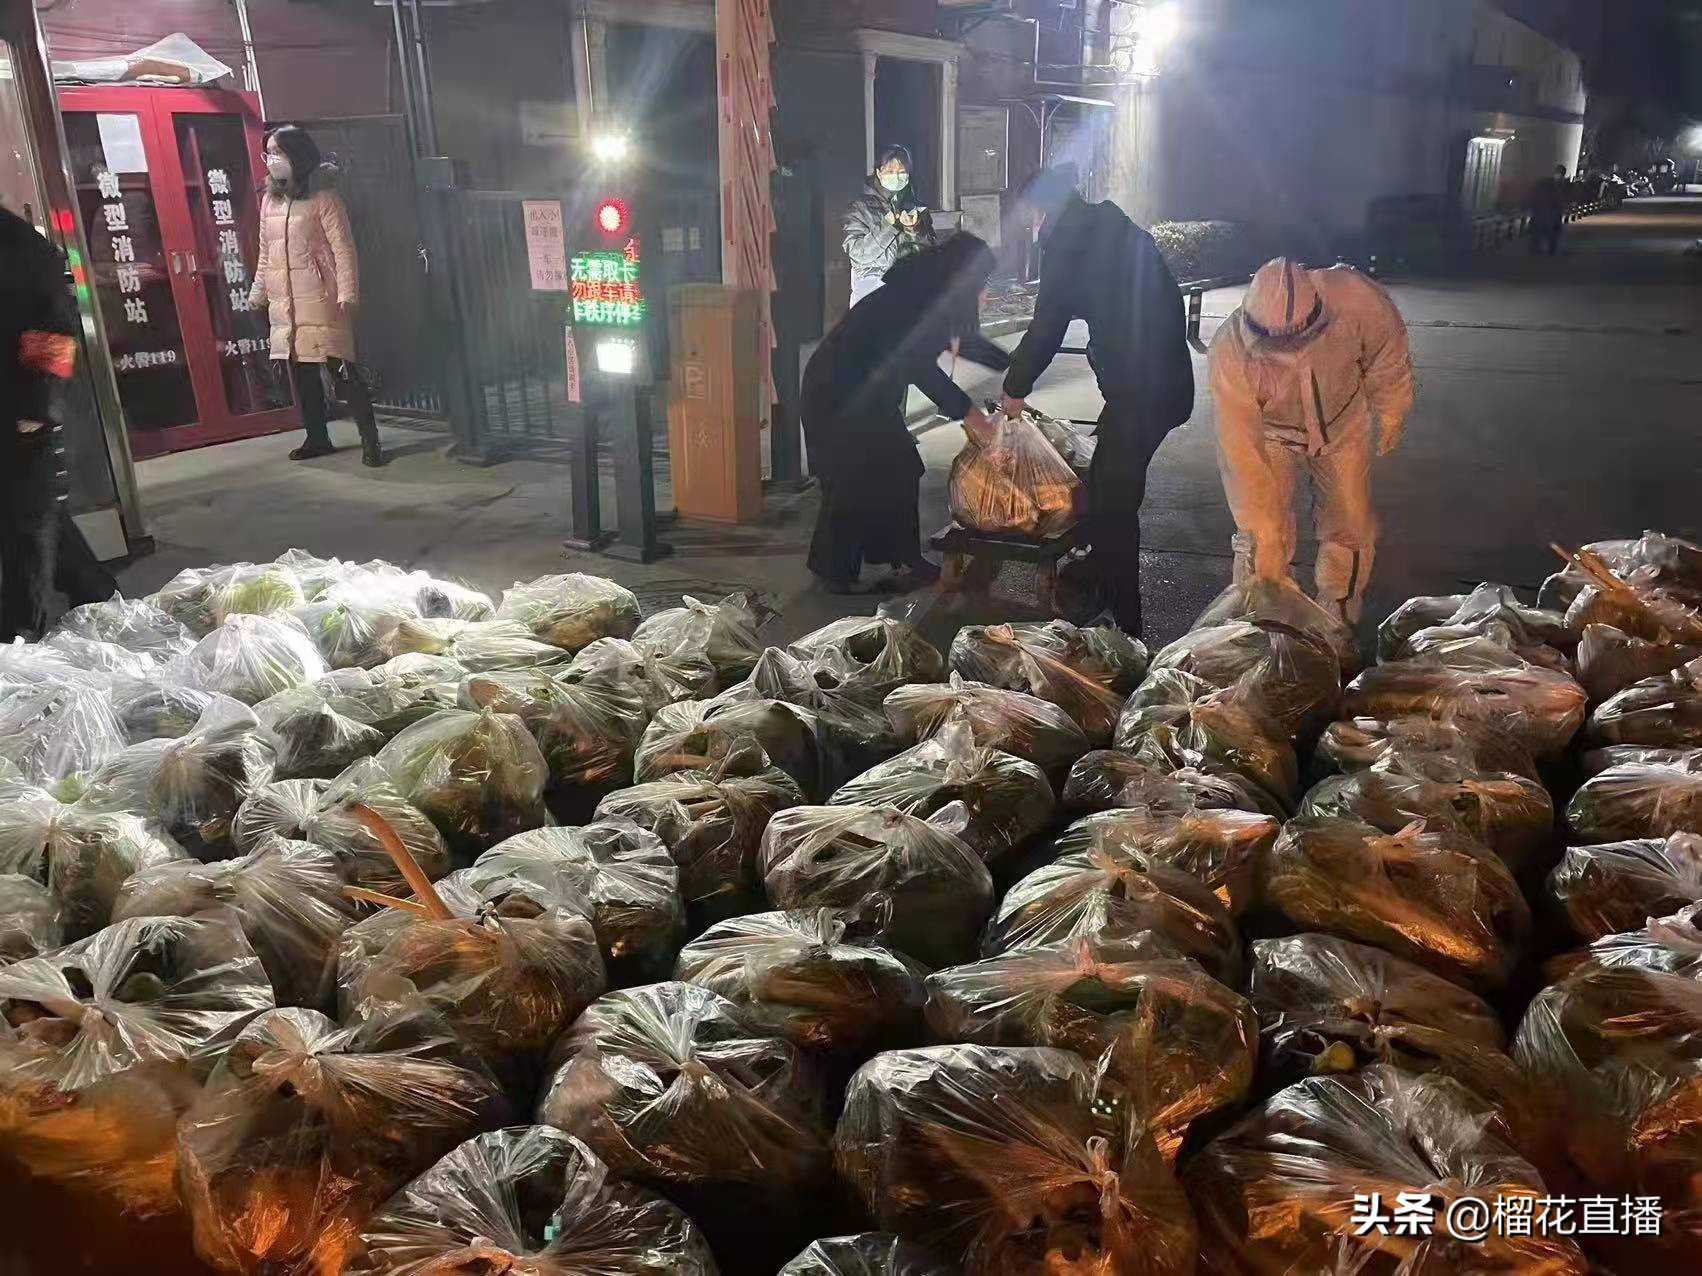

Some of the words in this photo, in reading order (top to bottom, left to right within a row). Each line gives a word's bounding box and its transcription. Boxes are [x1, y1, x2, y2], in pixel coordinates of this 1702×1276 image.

[97, 172, 149, 324] 微型消防站
[207, 168, 250, 312] 微型消防站
[571, 258, 640, 282] 无需取卡
[120, 350, 176, 371] 火警119
